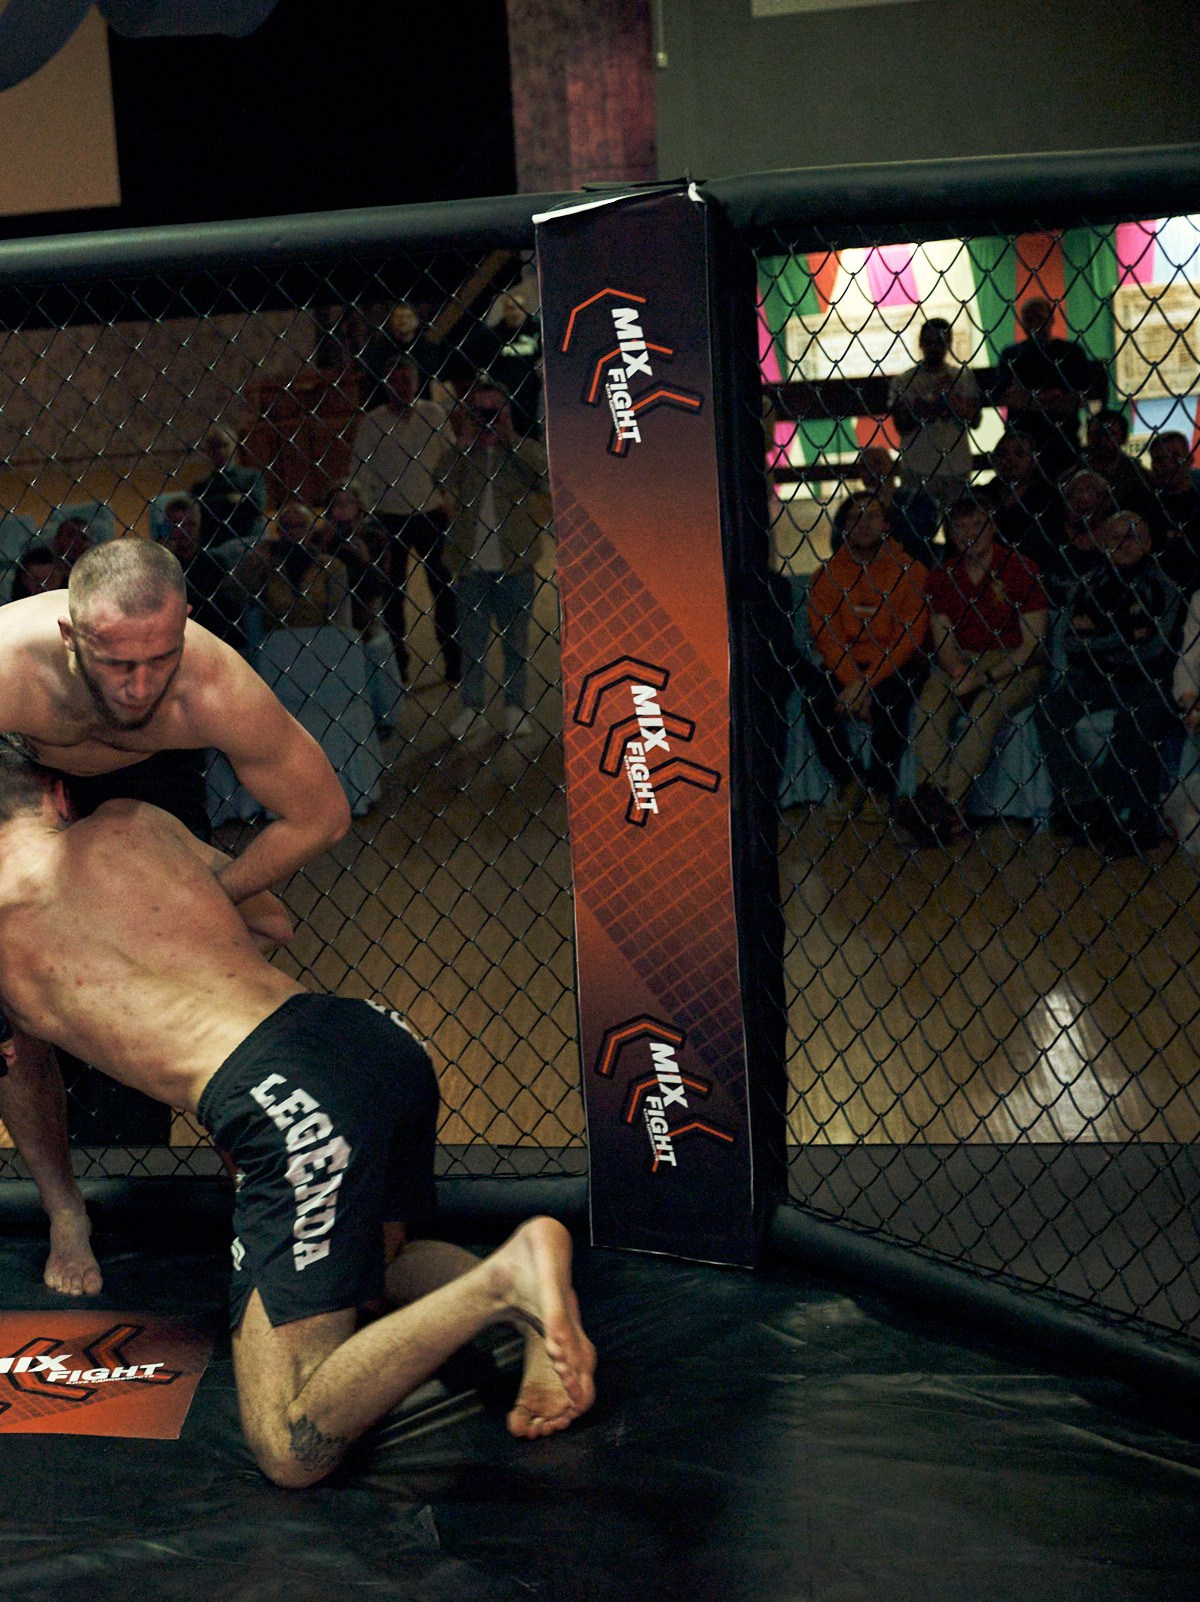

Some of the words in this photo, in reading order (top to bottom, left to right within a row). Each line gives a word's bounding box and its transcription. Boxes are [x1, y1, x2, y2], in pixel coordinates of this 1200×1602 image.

[611, 307, 653, 379] MIX
[608, 368, 642, 443] FIGHT
[630, 685, 670, 753] MIX
[626, 741, 659, 814] FIGHT
[649, 1042, 689, 1108] MIX
[646, 1095, 677, 1167] FIGHT
[250, 1073, 352, 1272] LEGENDA
[46, 1362, 165, 1383] FIGHT
